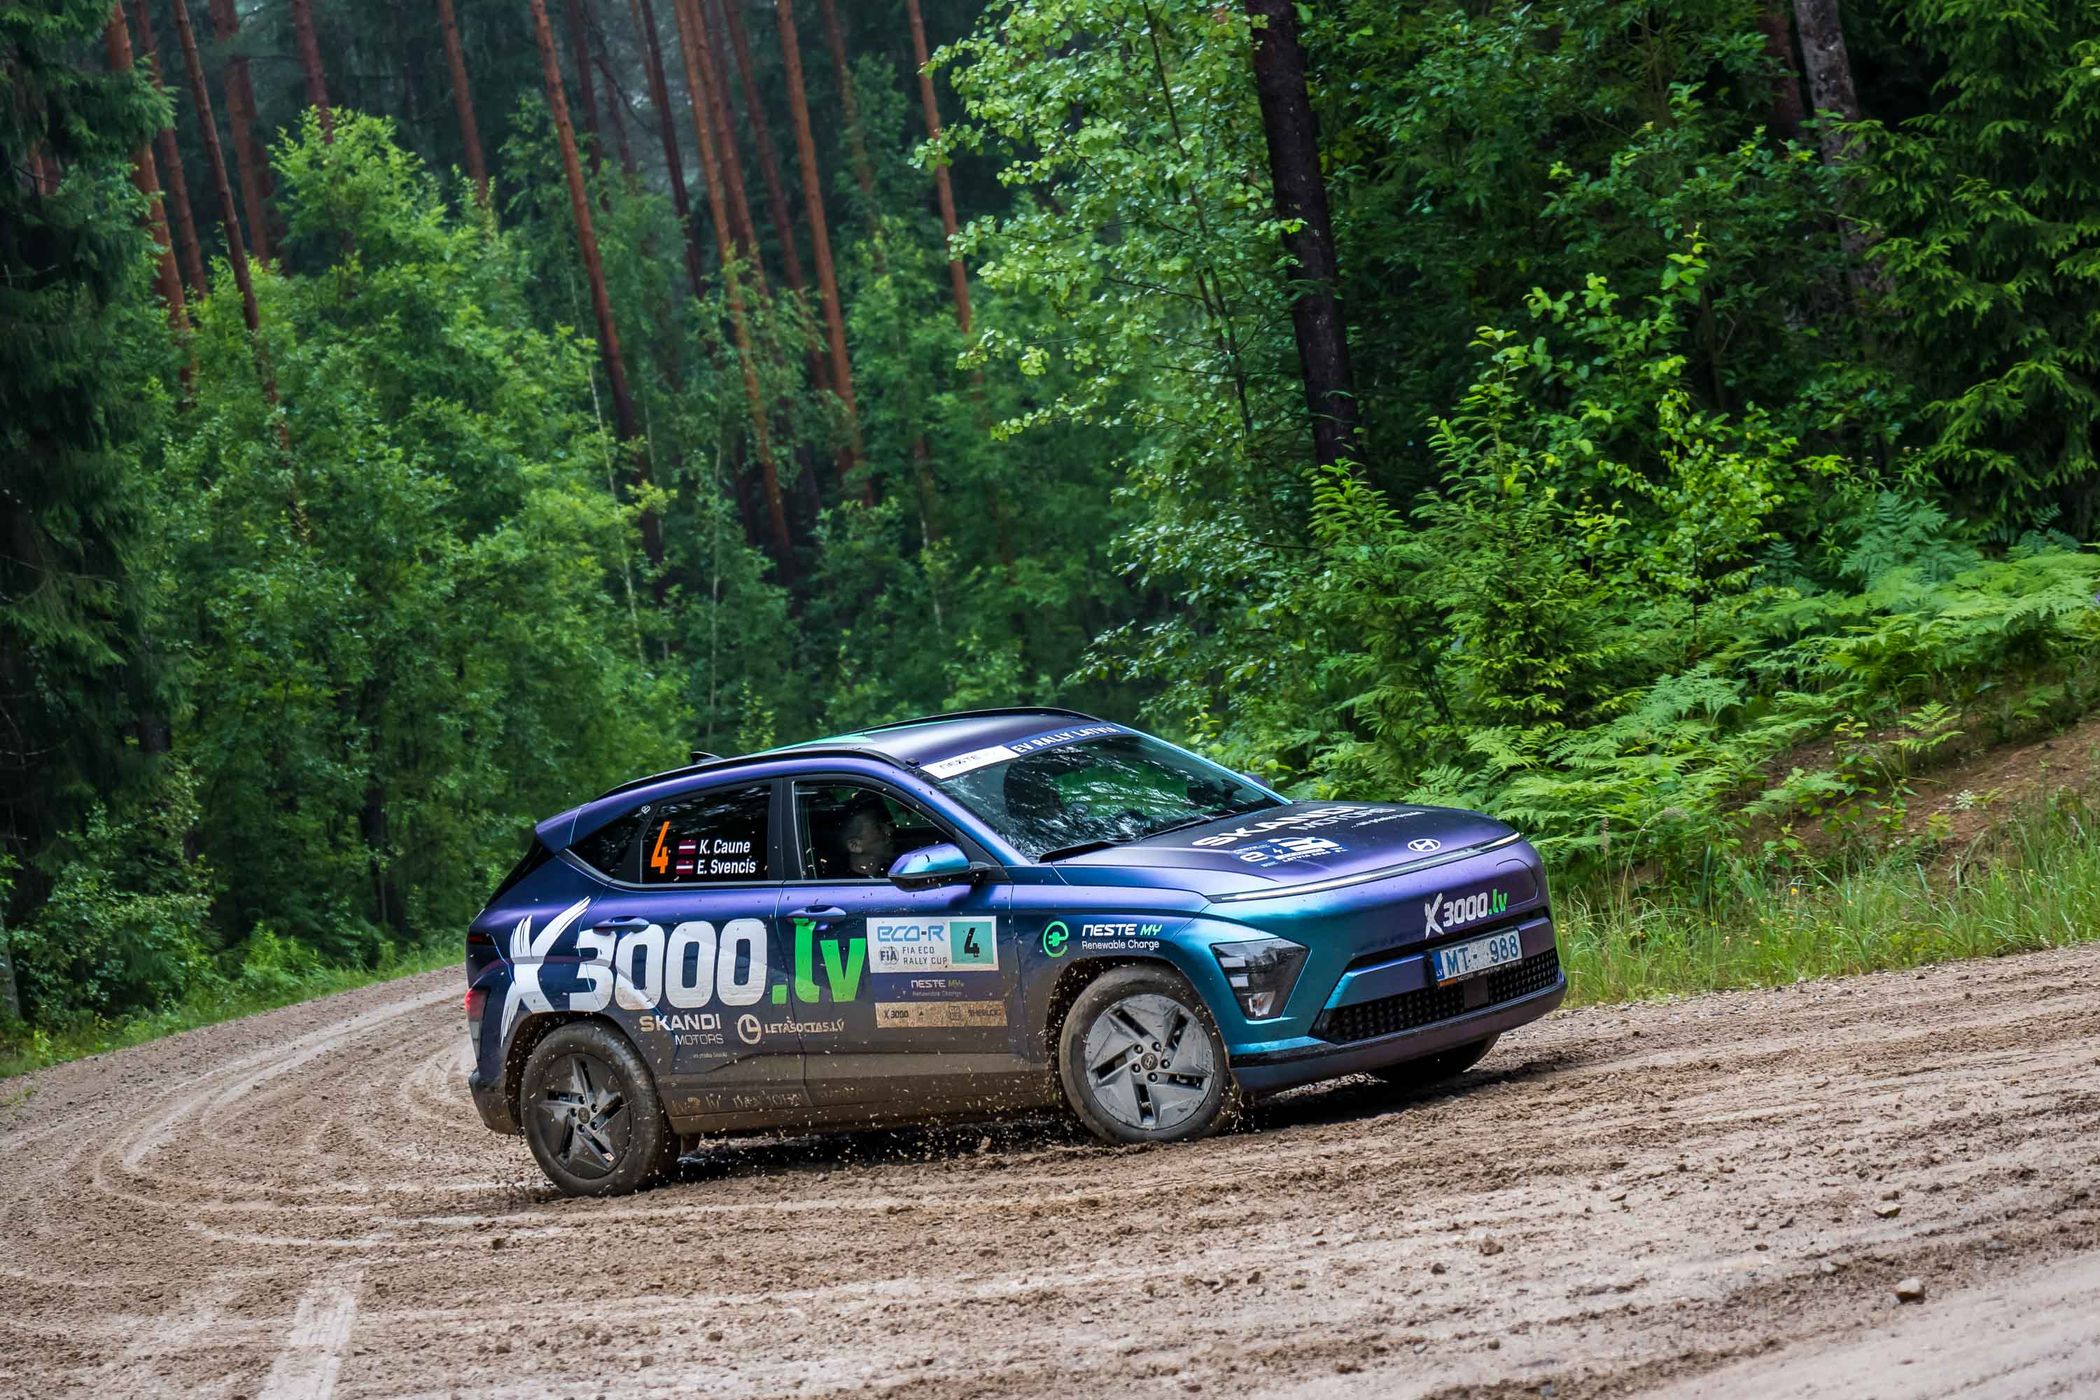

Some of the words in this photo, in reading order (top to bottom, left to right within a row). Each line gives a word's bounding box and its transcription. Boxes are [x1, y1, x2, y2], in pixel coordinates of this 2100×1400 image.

[1011, 742, 1034, 753] EV
[1030, 732, 1074, 747] RALLY
[1071, 726, 1121, 738] LATVIA
[1191, 806, 1371, 847] SKANDI
[650, 821, 670, 874] 4
[699, 839, 710, 854] K.
[713, 839, 751, 854] Caune
[697, 860, 708, 874] E.
[710, 858, 756, 874] Svencis
[1082, 923, 1138, 937] NESTE
[1140, 923, 1163, 936] MY
[963, 927, 980, 957] 4
[1081, 940, 1126, 951] Renewable
[1127, 939, 1160, 951] Charge
[902, 946, 916, 955] FIA
[918, 946, 935, 955] ECO
[903, 957, 928, 965] RALLY
[931, 956, 948, 965] CUP
[1435, 968, 1444, 977] LV
[911, 980, 947, 989] NESTE
[639, 1013, 722, 1032] SKANDI
[674, 1033, 725, 1046] MOTORS
